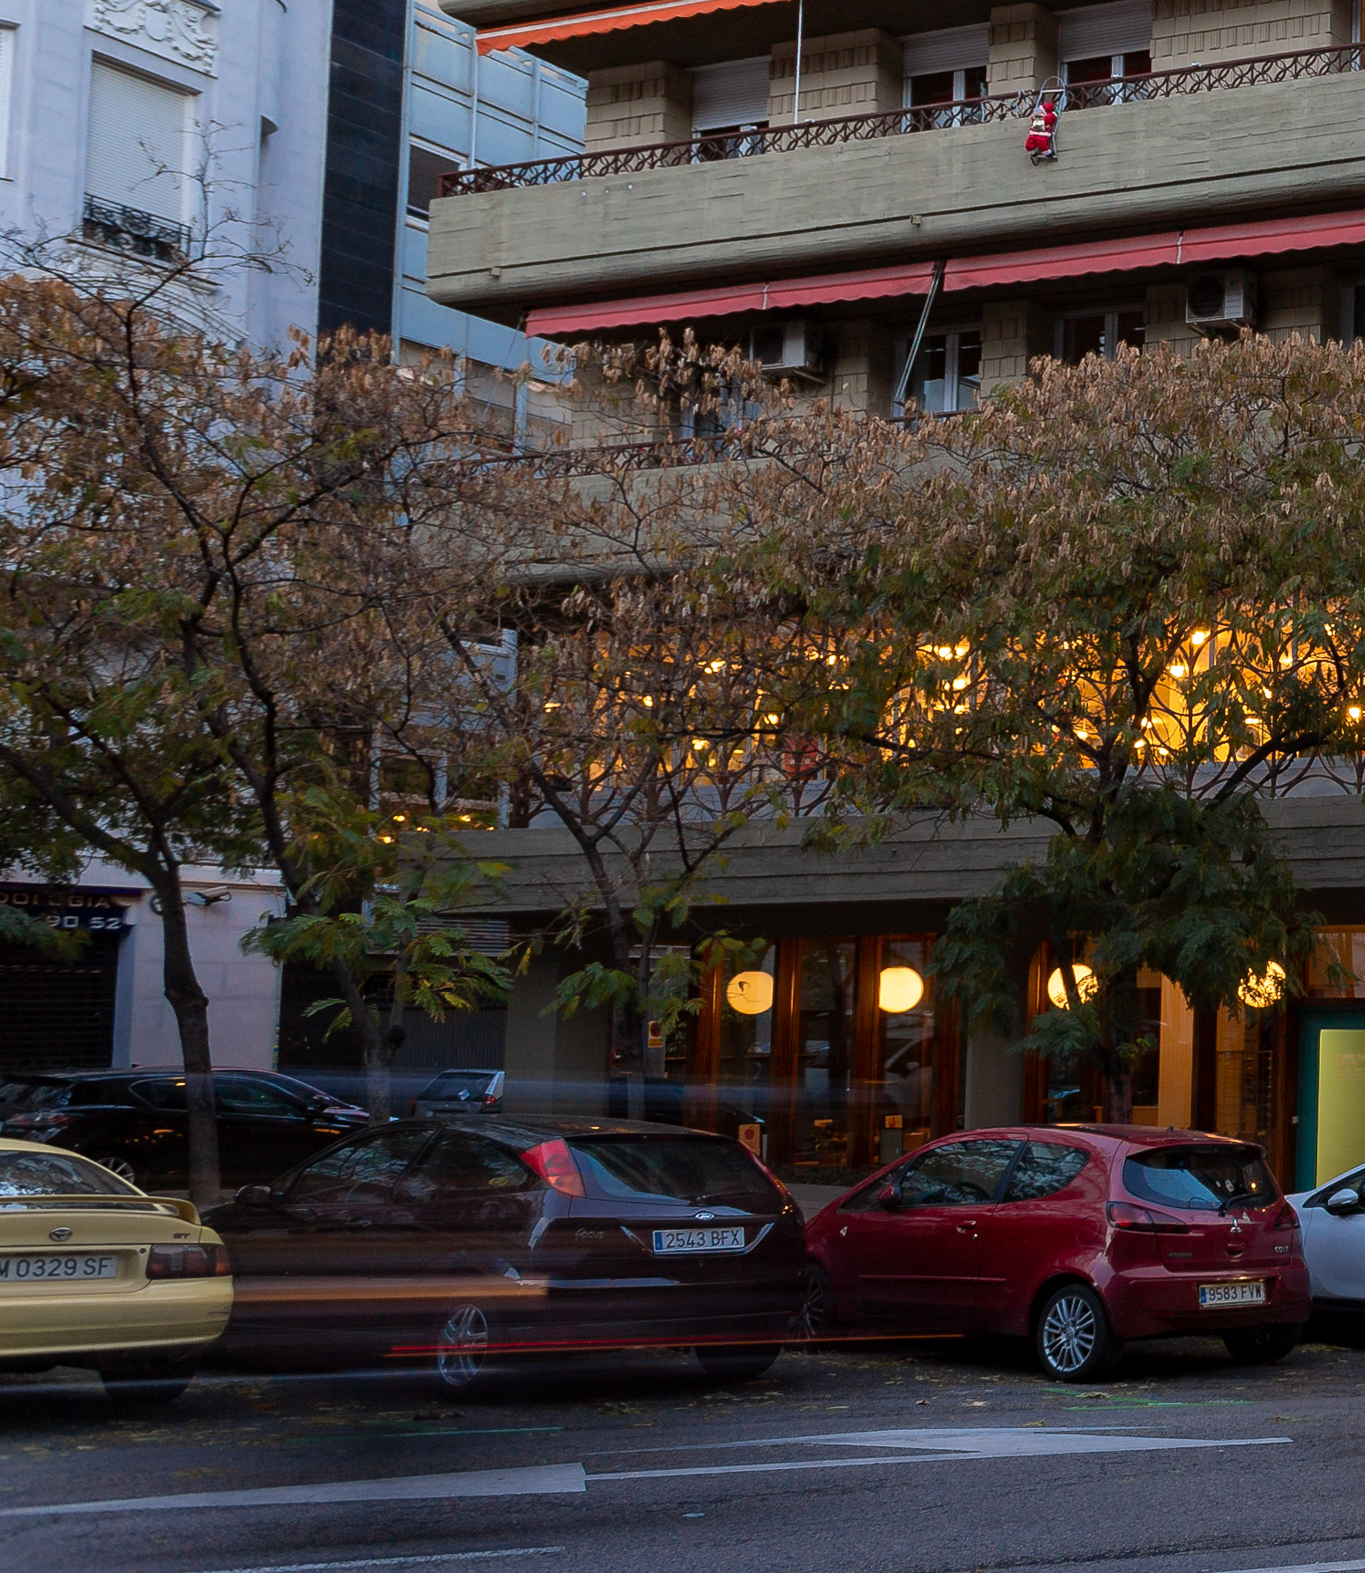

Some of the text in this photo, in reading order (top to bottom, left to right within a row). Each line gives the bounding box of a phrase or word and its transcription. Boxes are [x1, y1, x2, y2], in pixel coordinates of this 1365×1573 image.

[89, 917, 123, 931] 52
[666, 1230, 740, 1248] 2543 BFX
[16, 1258, 78, 1278] 0329
[83, 1257, 112, 1276] SF
[1208, 1285, 1262, 1301] 9583 FVW
